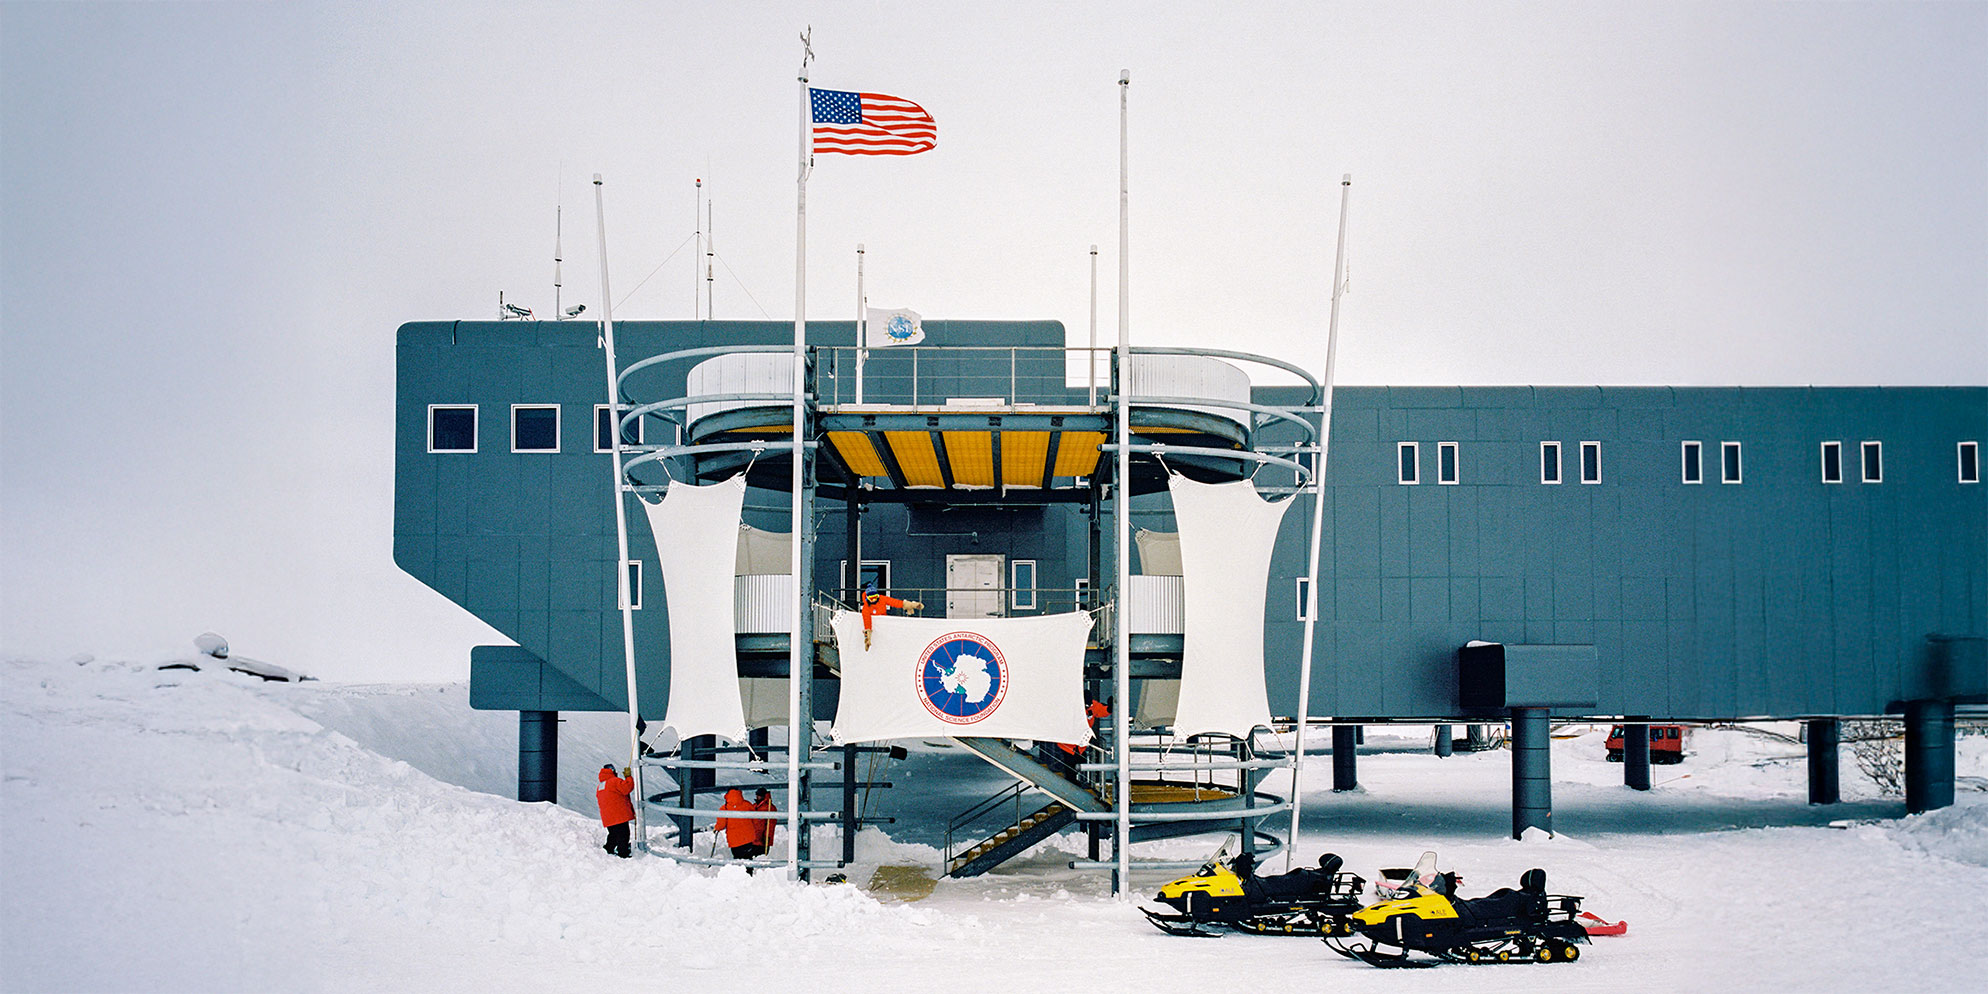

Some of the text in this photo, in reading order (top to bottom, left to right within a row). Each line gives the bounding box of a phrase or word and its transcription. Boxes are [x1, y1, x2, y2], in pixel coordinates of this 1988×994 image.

[921, 633, 1004, 665] UNITED STATES ANTARCTIC PROGRAM
[923, 697, 1001, 723] NATIONAL SCIENCE FOUNDATION
